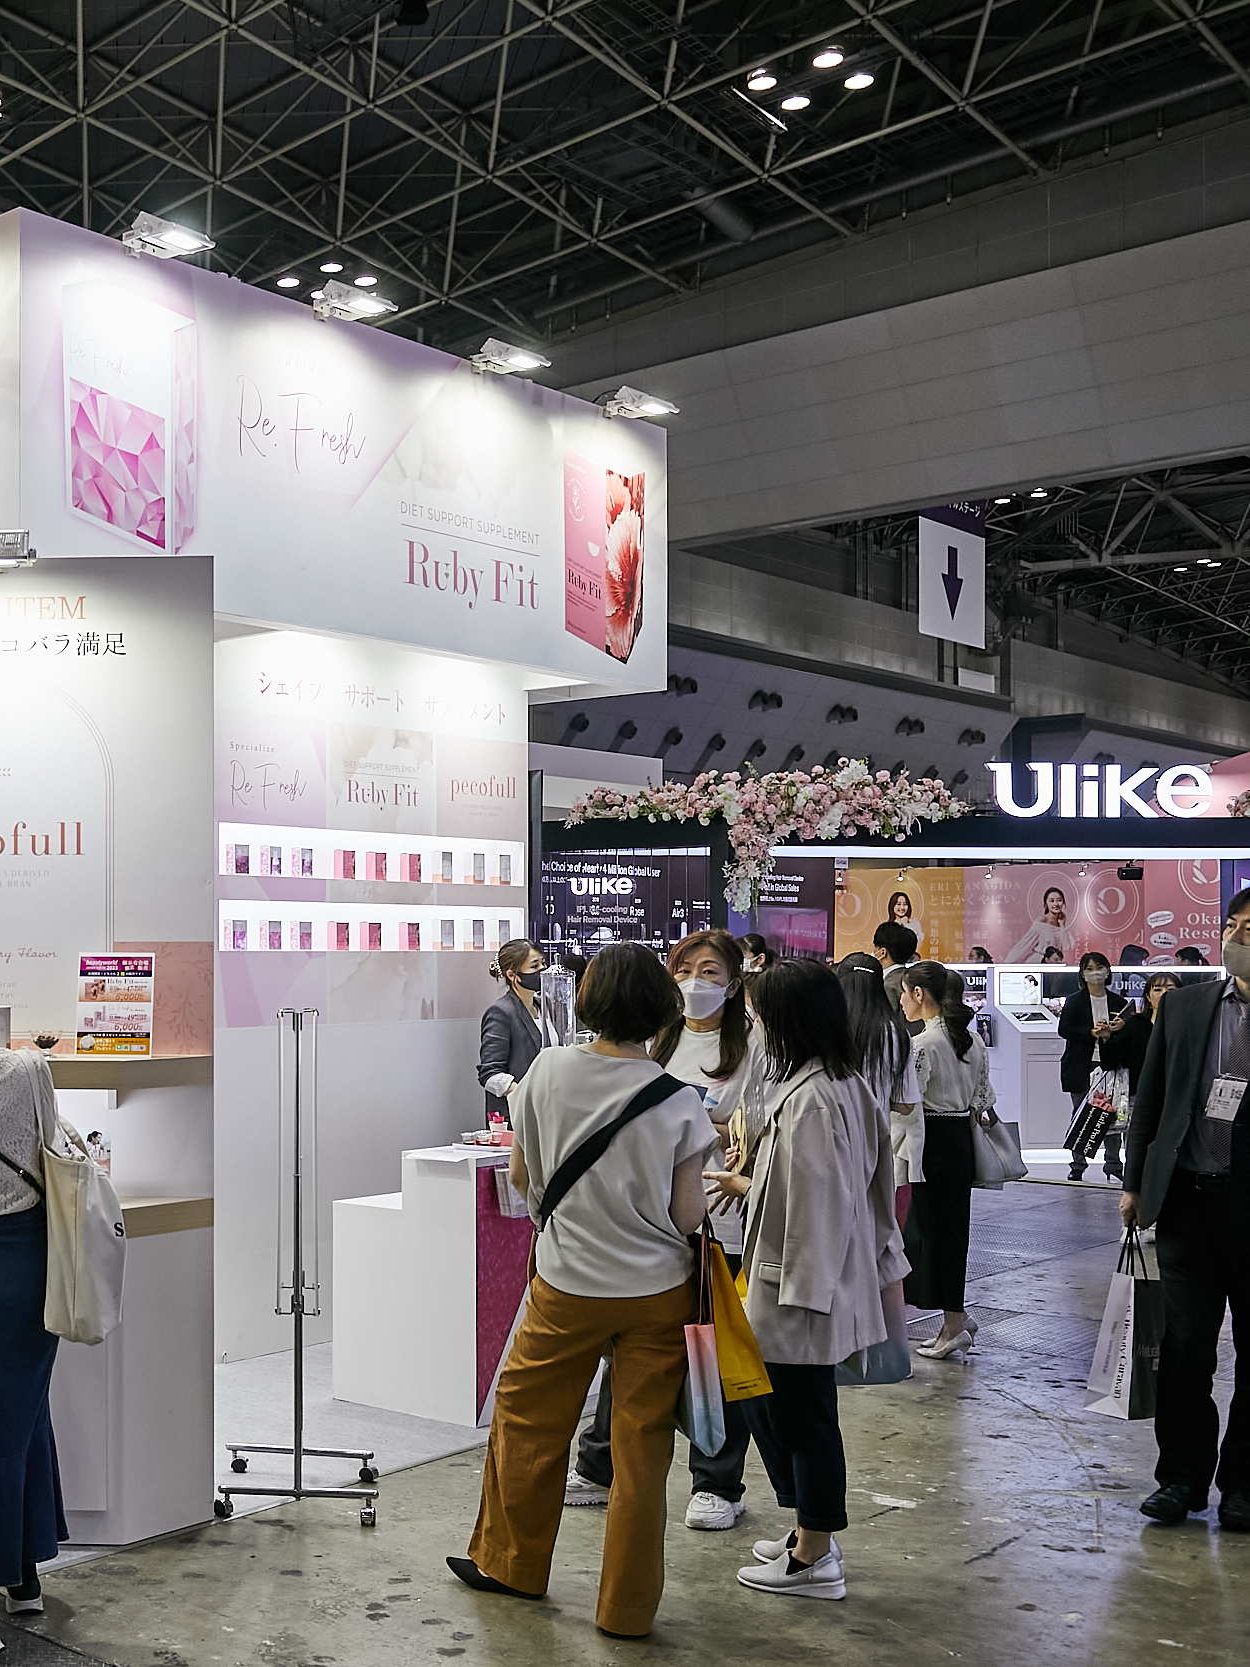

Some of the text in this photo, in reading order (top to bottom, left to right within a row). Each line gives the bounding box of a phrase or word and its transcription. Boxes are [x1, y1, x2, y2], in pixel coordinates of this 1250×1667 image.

[400, 501, 540, 546] DIET SUPPORT SUPPLEMENT
[403, 538, 540, 610] Ruby Fit
[567, 569, 589, 595] Ruby
[589, 579, 602, 600] Fit
[4, 596, 87, 620] ITEM
[345, 684, 405, 713] サポート
[229, 741, 276, 754] Specialize
[344, 760, 419, 774] DIET SUPPORT SUPPLEMENT
[346, 779, 419, 811] Ruby Fit
[450, 775, 516, 801] pecofull
[984, 762, 1213, 818] Ulike
[570, 876, 634, 896] Ulike
[955, 881, 1021, 891] YANAGIDA
[567, 915, 638, 923] Hair Removal Device
[1187, 913, 1221, 925] Oka
[1179, 927, 1220, 939] Resc
[18, 947, 59, 959] Flavor
[1114, 1354, 1128, 1399] Caravan
